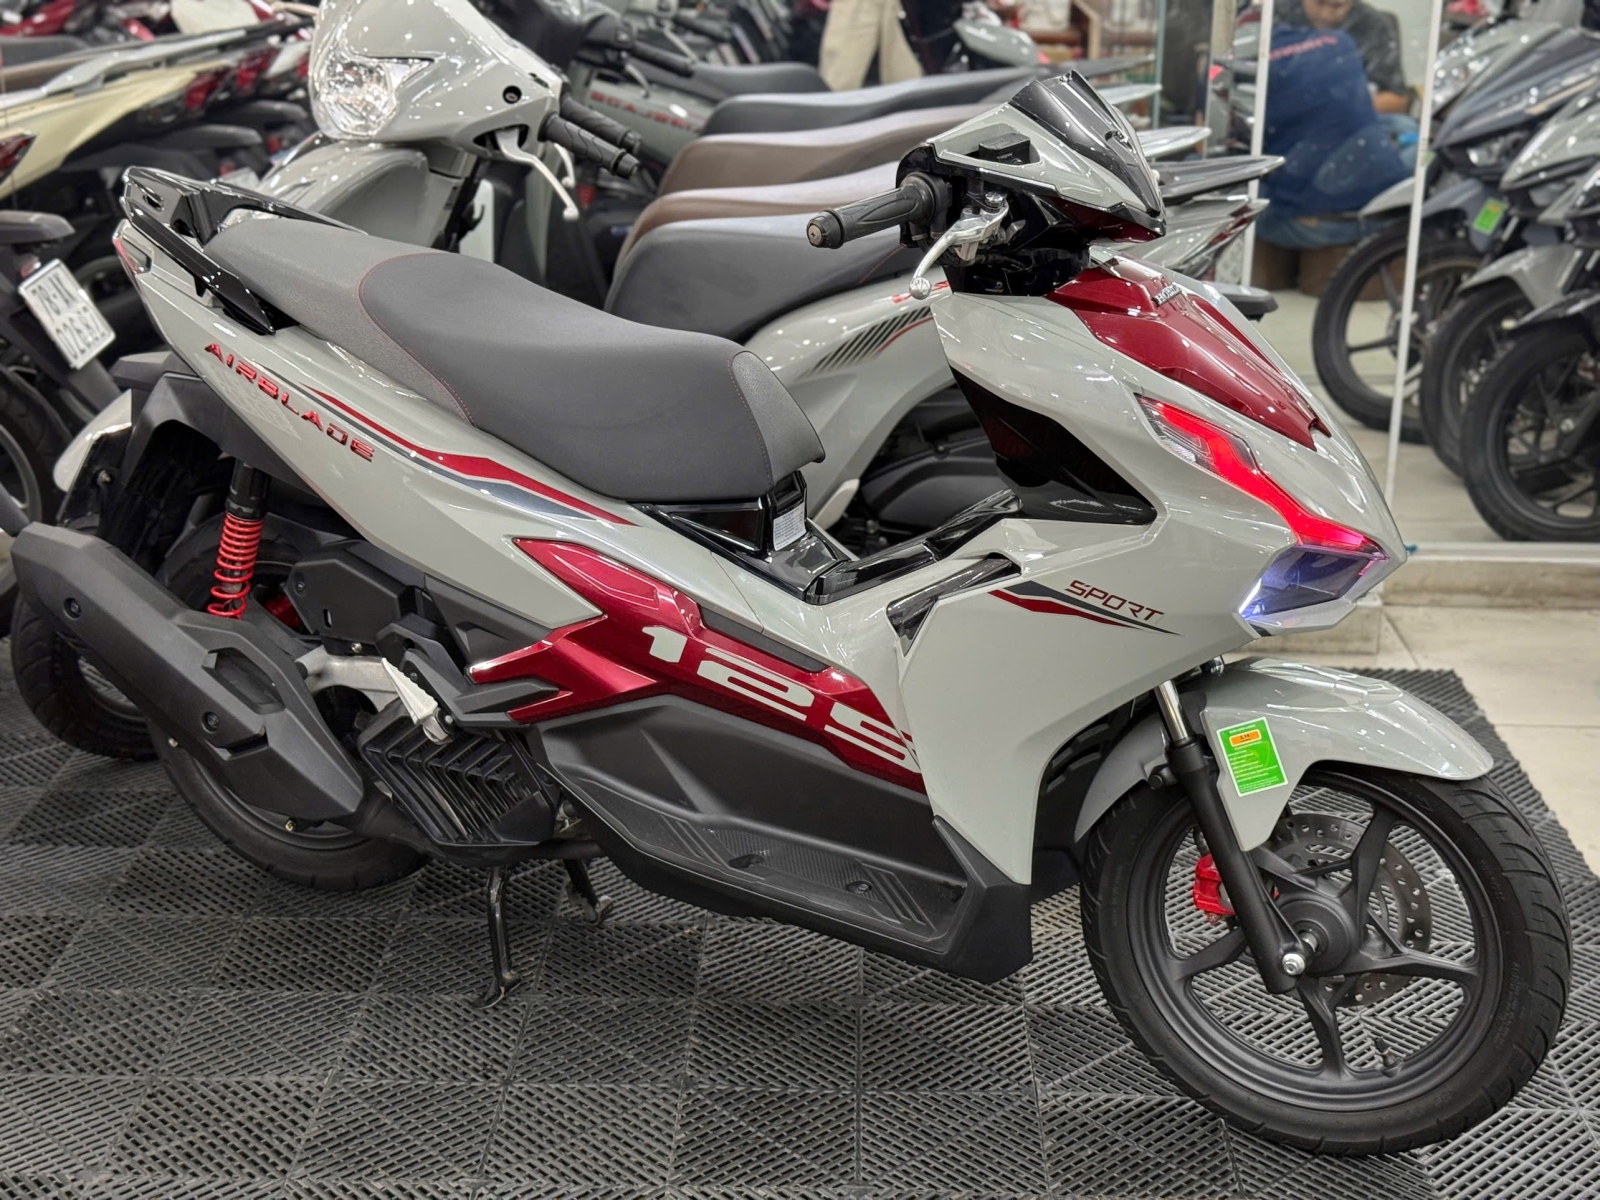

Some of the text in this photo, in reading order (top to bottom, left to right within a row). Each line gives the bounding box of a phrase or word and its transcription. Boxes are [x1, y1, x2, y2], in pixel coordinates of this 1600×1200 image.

[204, 342, 375, 463] AIRBLADE
[1064, 579, 1164, 621] SPORT
[641, 625, 921, 773] 125
